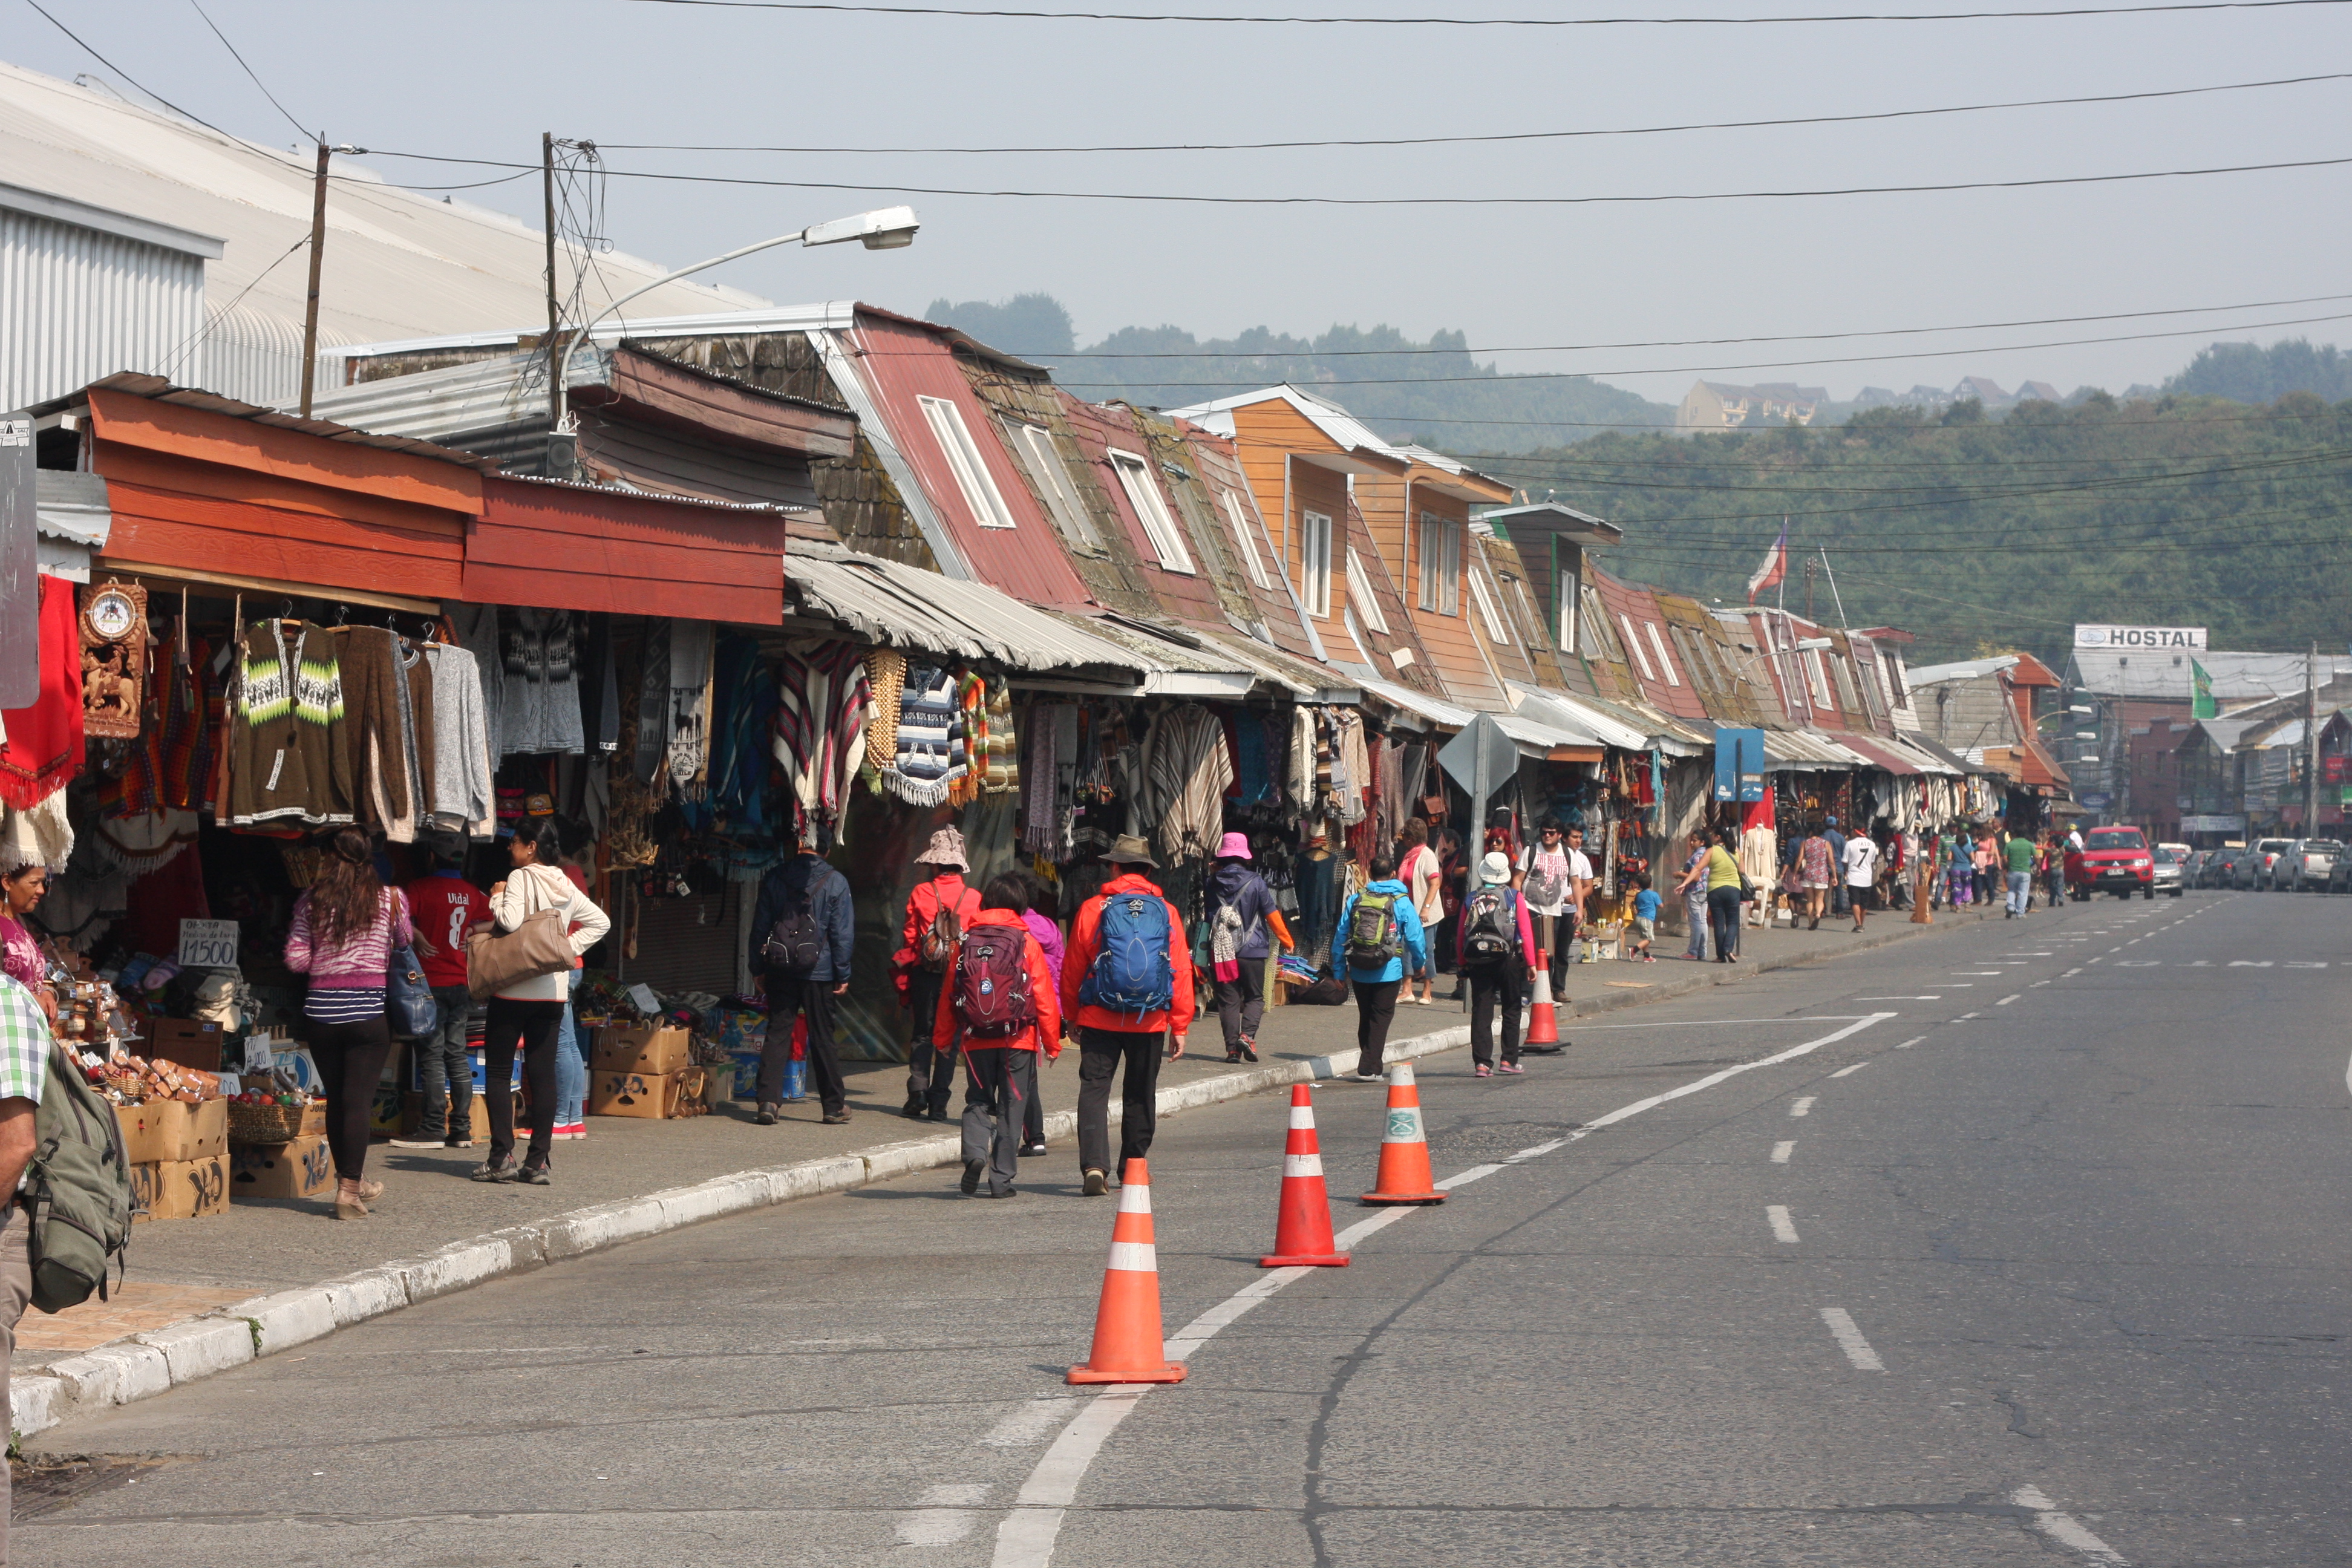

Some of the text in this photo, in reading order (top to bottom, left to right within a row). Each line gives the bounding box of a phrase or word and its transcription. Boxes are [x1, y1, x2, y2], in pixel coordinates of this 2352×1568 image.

[2111, 630, 2198, 647] HOSTAL
[1537, 853, 1547, 864] THE
[1857, 848, 1869, 867] 7
[449, 906, 466, 950] 8
